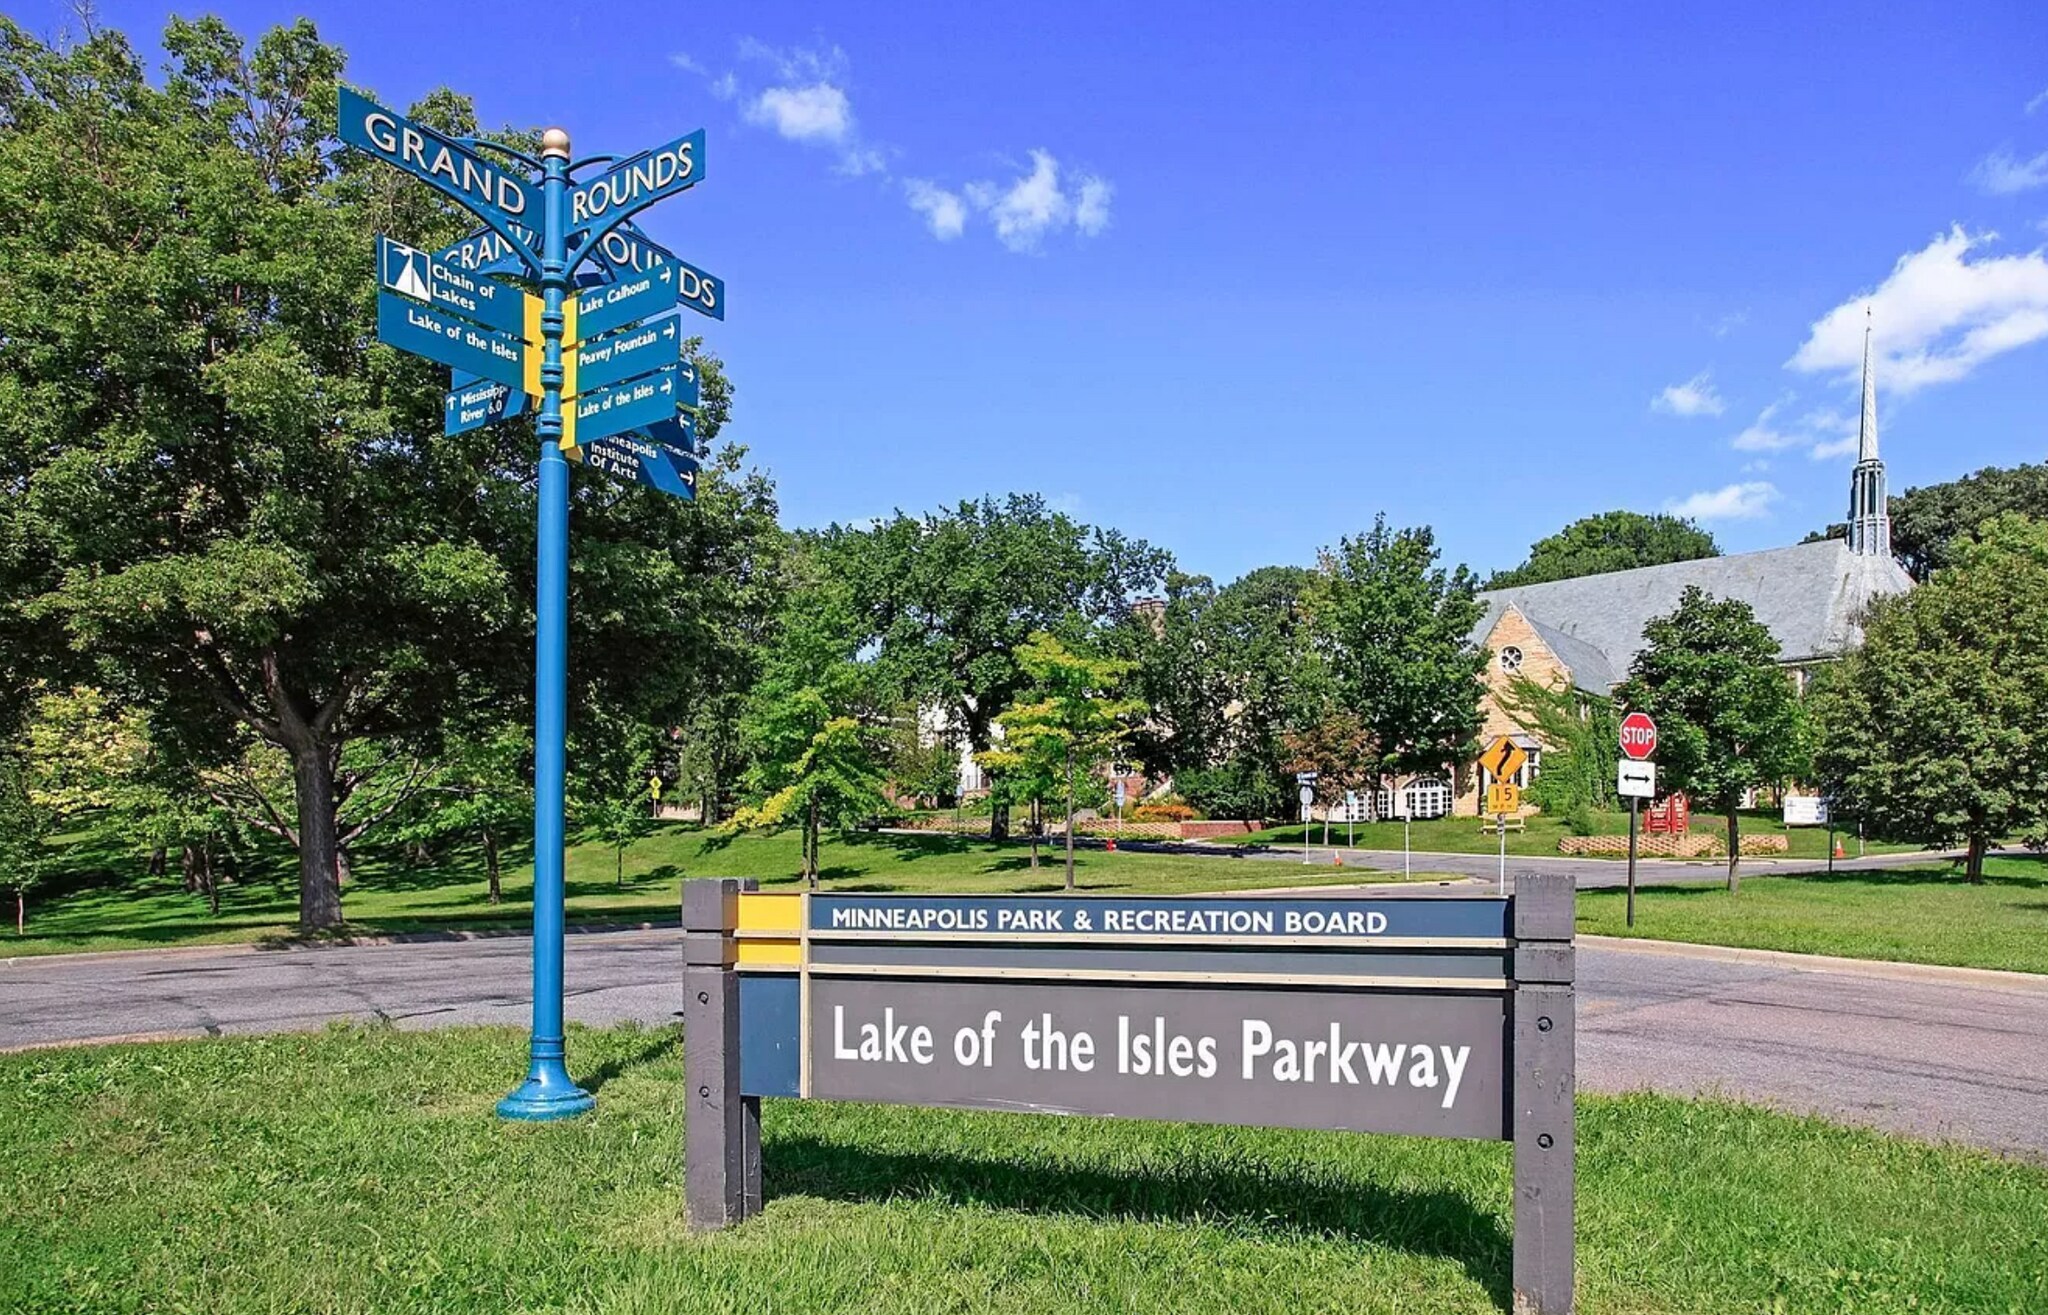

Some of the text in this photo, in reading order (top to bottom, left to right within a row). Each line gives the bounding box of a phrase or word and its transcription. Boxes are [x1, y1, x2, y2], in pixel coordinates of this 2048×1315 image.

[364, 112, 526, 216] GRAND
[572, 142, 693, 224] ROUNDS
[432, 264, 496, 300] Chain of
[432, 282, 476, 311] Lakes
[579, 279, 651, 316] Lake Calhoun
[408, 308, 518, 362] Lake of the Isles
[579, 330, 657, 367] Peavey Fountain
[460, 408, 485, 424] River
[577, 384, 654, 418] Lake of the Isles
[590, 454, 637, 480] Of Arts
[591, 442, 640, 468] Institute
[1622, 727, 1654, 745] STOP
[1495, 787, 1513, 801] 15
[831, 908, 1388, 934] MINNEAPOLIS PARK & RECREATION BOARD
[833, 1004, 1471, 1109] Lake of the Isles Parkway
